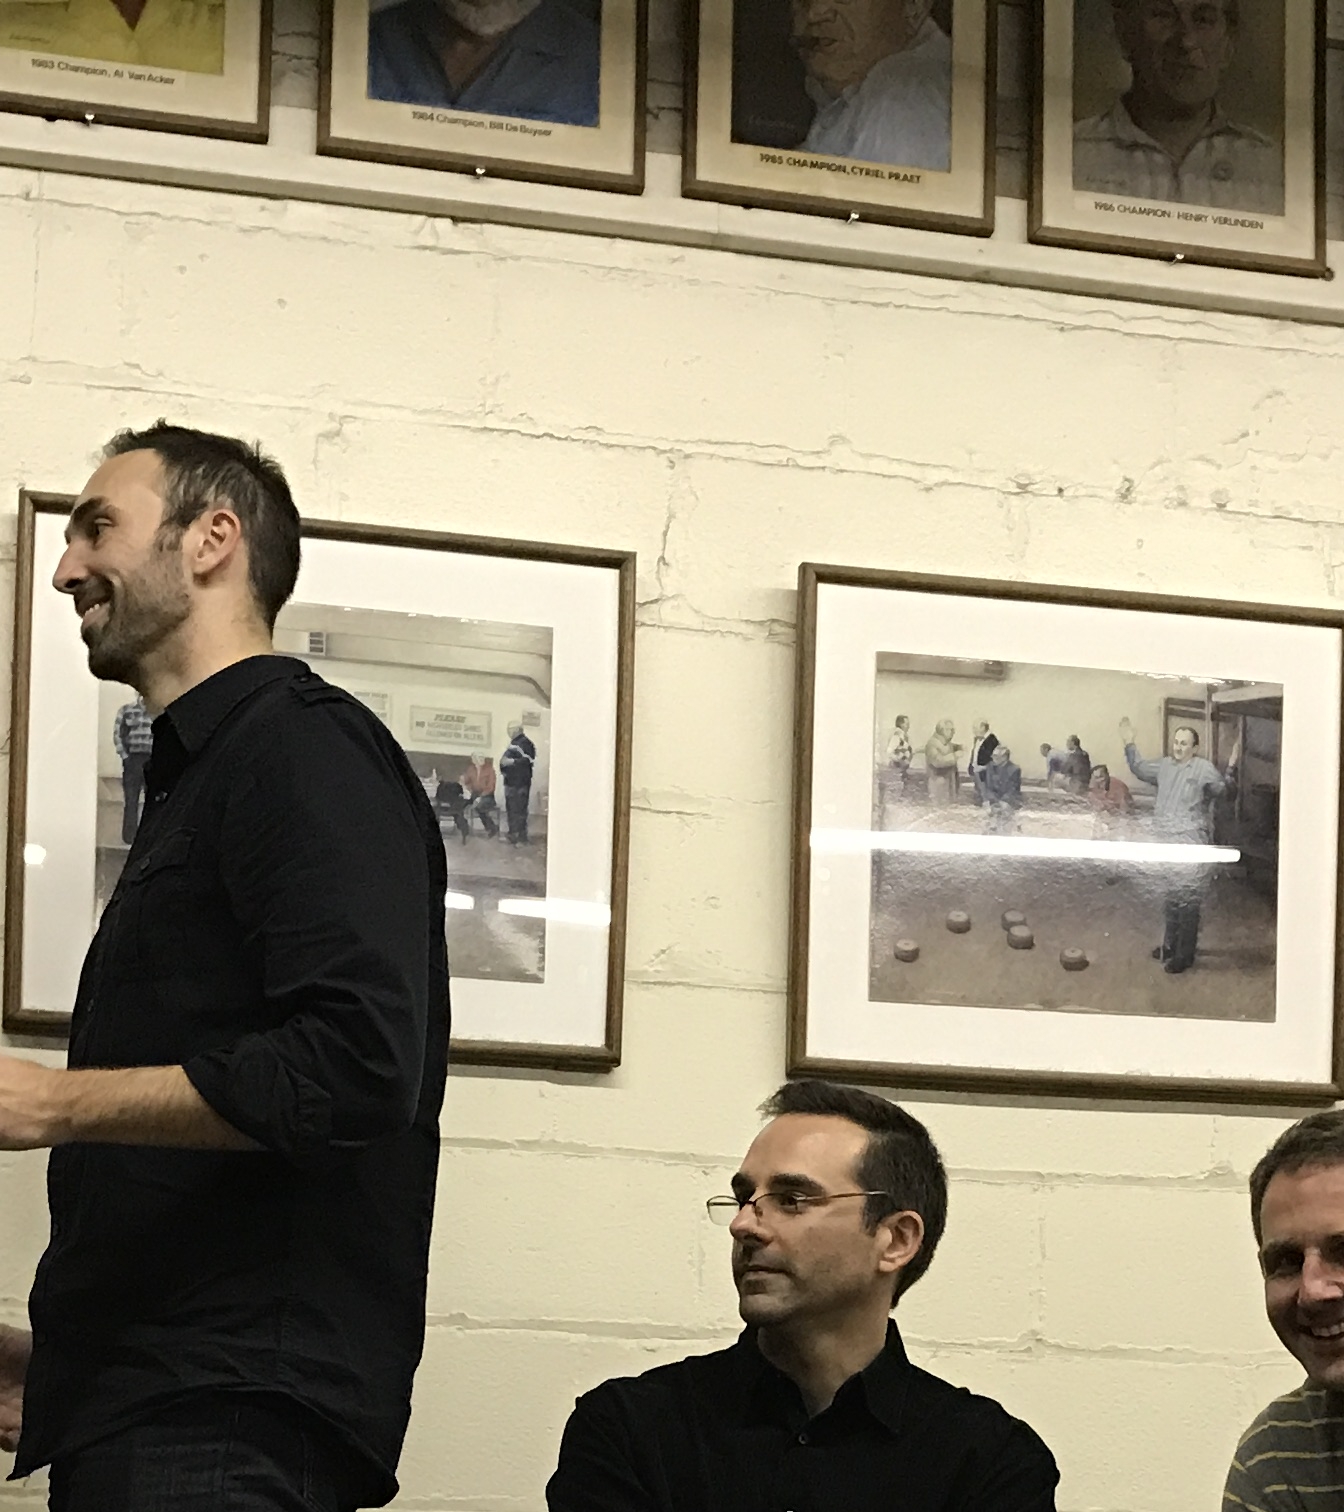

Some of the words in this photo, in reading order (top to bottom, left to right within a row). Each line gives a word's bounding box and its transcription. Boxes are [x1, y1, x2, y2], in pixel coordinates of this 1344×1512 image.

[489, 120, 504, 130] Bill
[759, 153, 784, 165] 1985
[786, 156, 851, 175] CHAMPION,
[851, 166, 885, 180] CYRIEL
[888, 171, 921, 184] PRAET
[1094, 201, 1115, 213] 1986
[1177, 211, 1208, 223] HENRY
[1211, 215, 1264, 230] VERLINDEN
